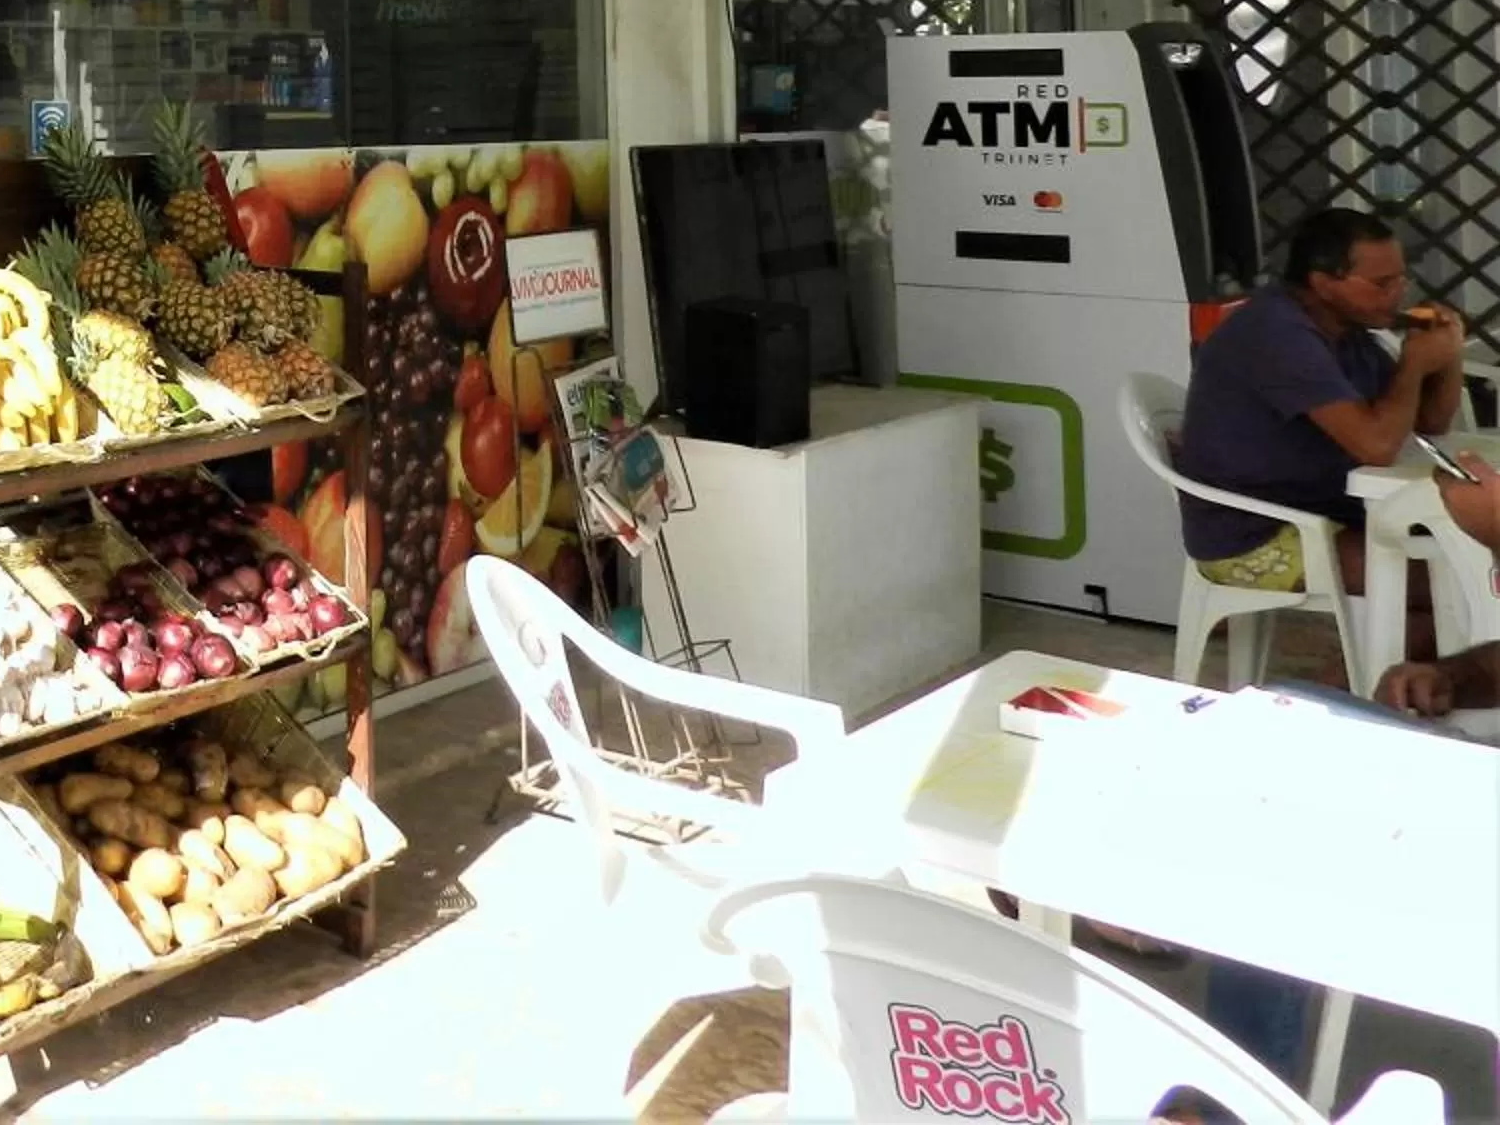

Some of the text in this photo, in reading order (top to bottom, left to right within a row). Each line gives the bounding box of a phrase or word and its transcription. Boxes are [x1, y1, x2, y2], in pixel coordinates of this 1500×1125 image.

[1017, 84, 1069, 98] RED
[922, 101, 1070, 148] ATM
[983, 194, 1017, 206] VISA
[888, 1003, 1036, 1072] Red
[890, 1050, 1072, 1124] Rock
